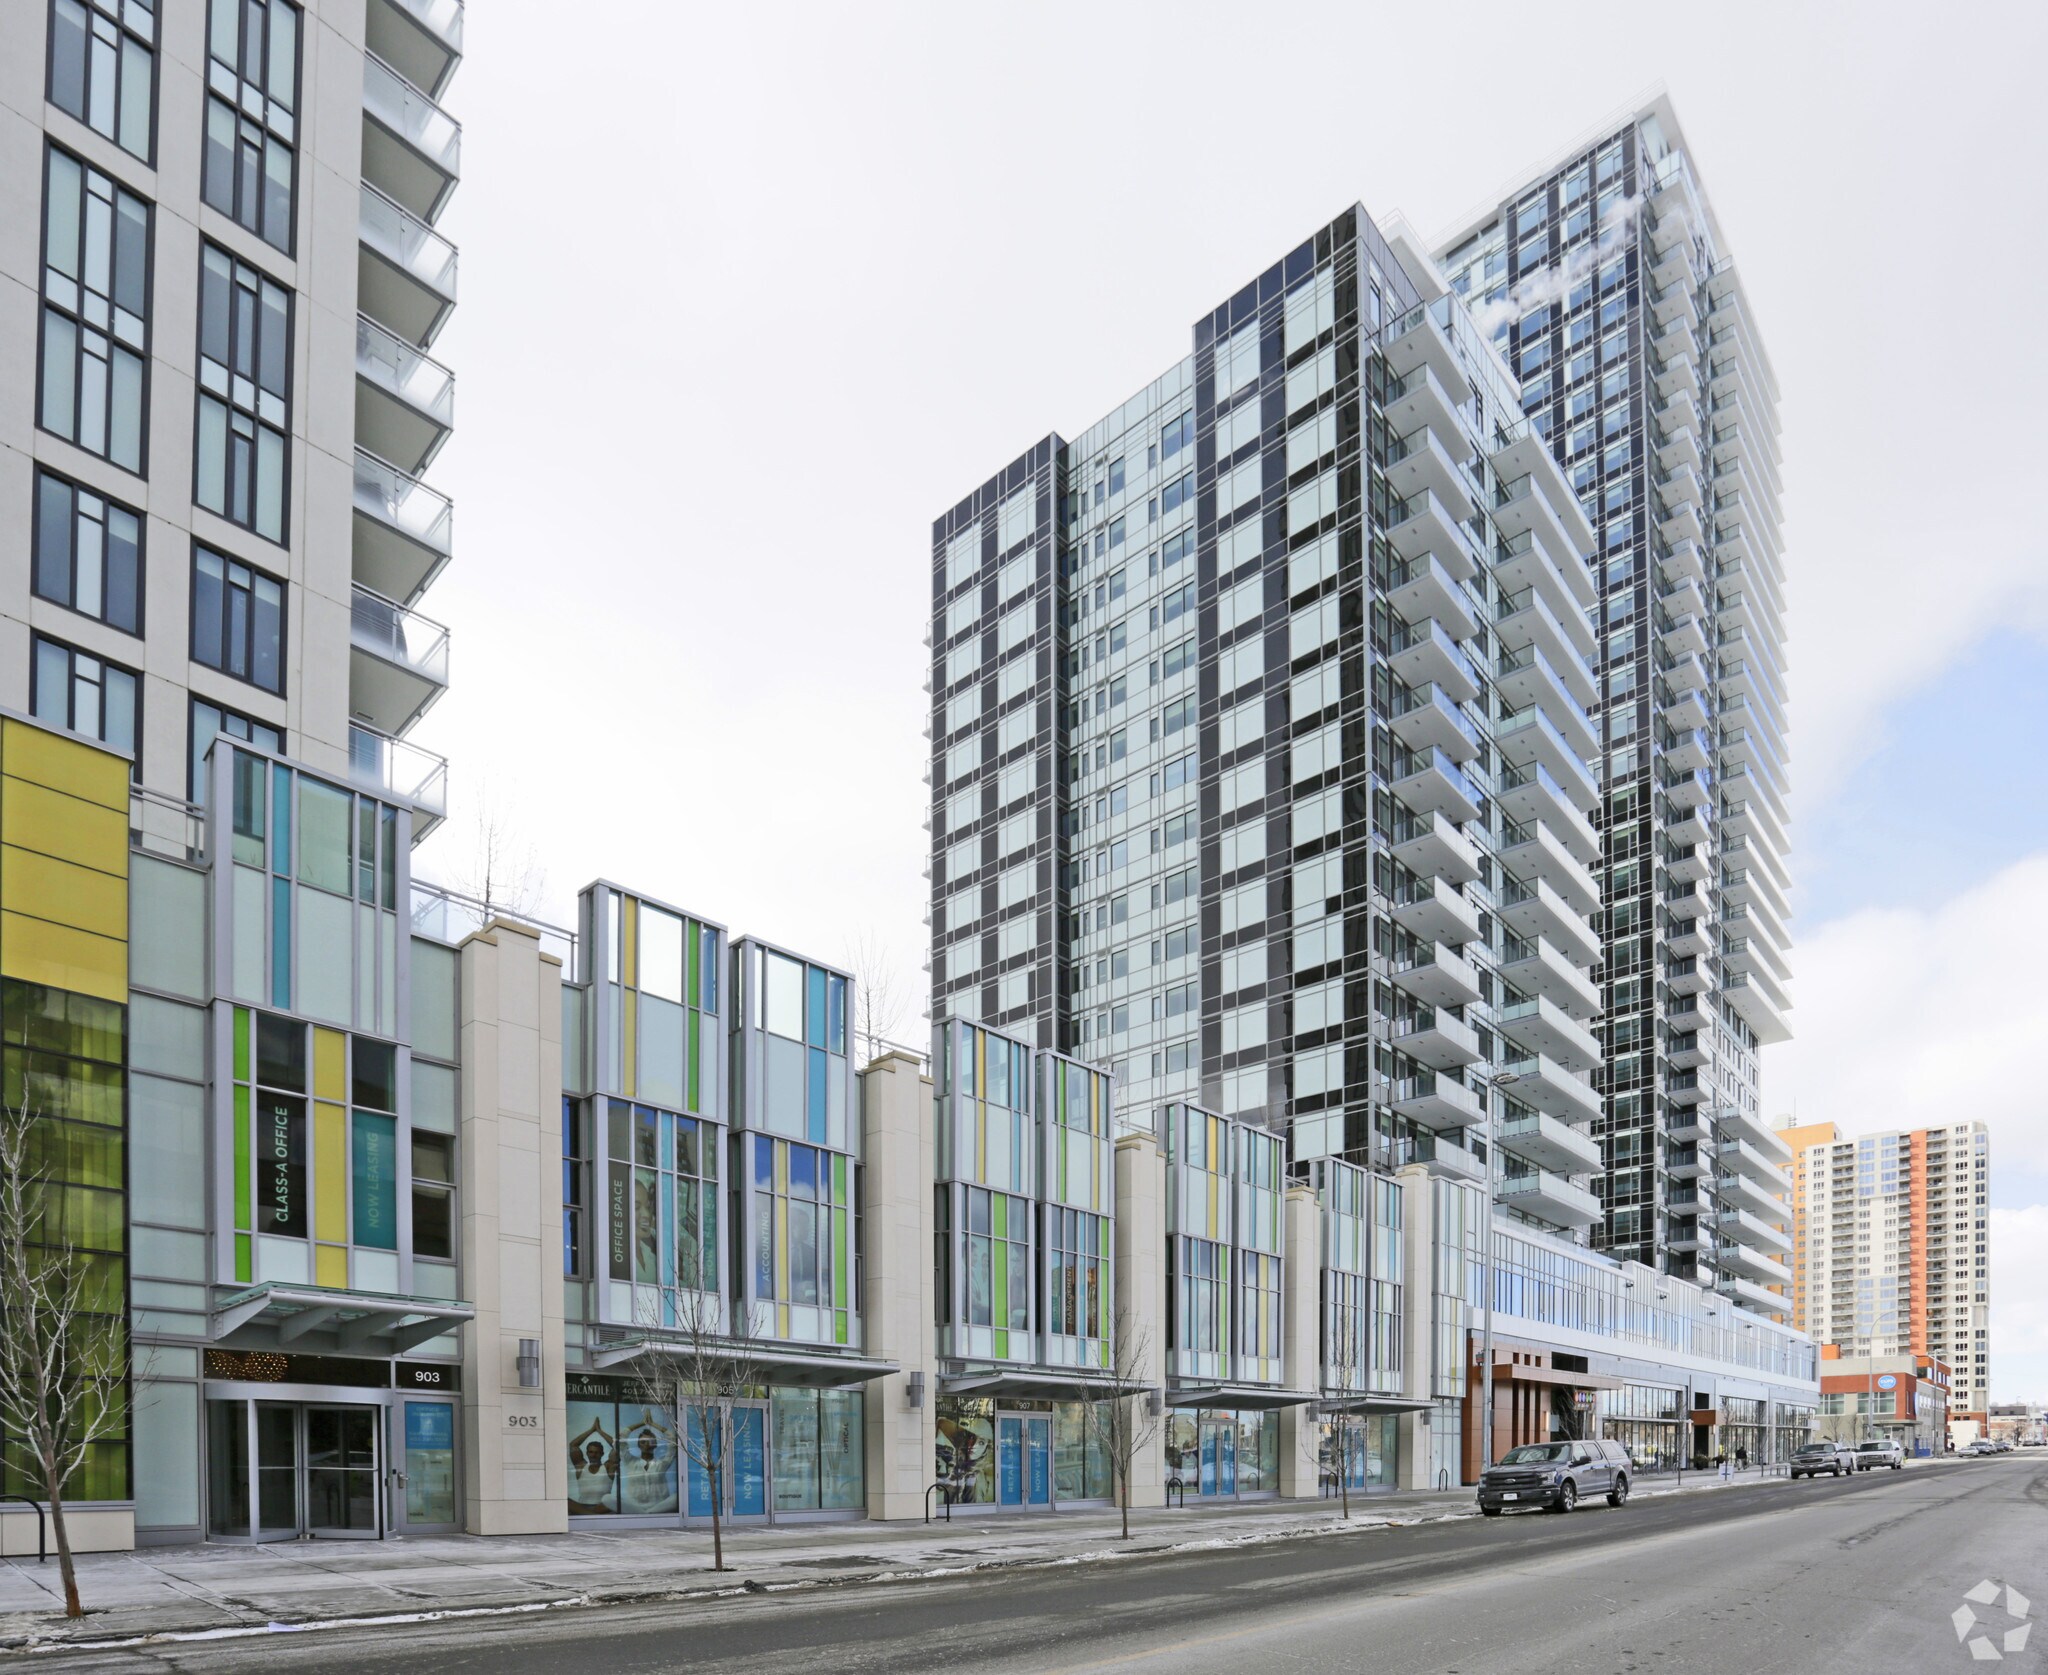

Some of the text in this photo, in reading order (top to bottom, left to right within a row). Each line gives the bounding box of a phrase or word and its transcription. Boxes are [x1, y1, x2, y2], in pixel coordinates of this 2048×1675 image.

[275, 1106, 289, 1222] CLASS-A OFFICE
[367, 1132, 379, 1228] NOW LEASING
[613, 1179, 624, 1263] OFFICE SPACE
[761, 1211, 770, 1282] ACCOUNTING
[415, 1370, 440, 1383] 903
[566, 1383, 610, 1396] ERCANTILE
[717, 1385, 734, 1395] 905
[508, 1415, 537, 1427] 903
[1019, 1402, 1031, 1410] 907
[743, 1423, 752, 1499] NOW LEASING
